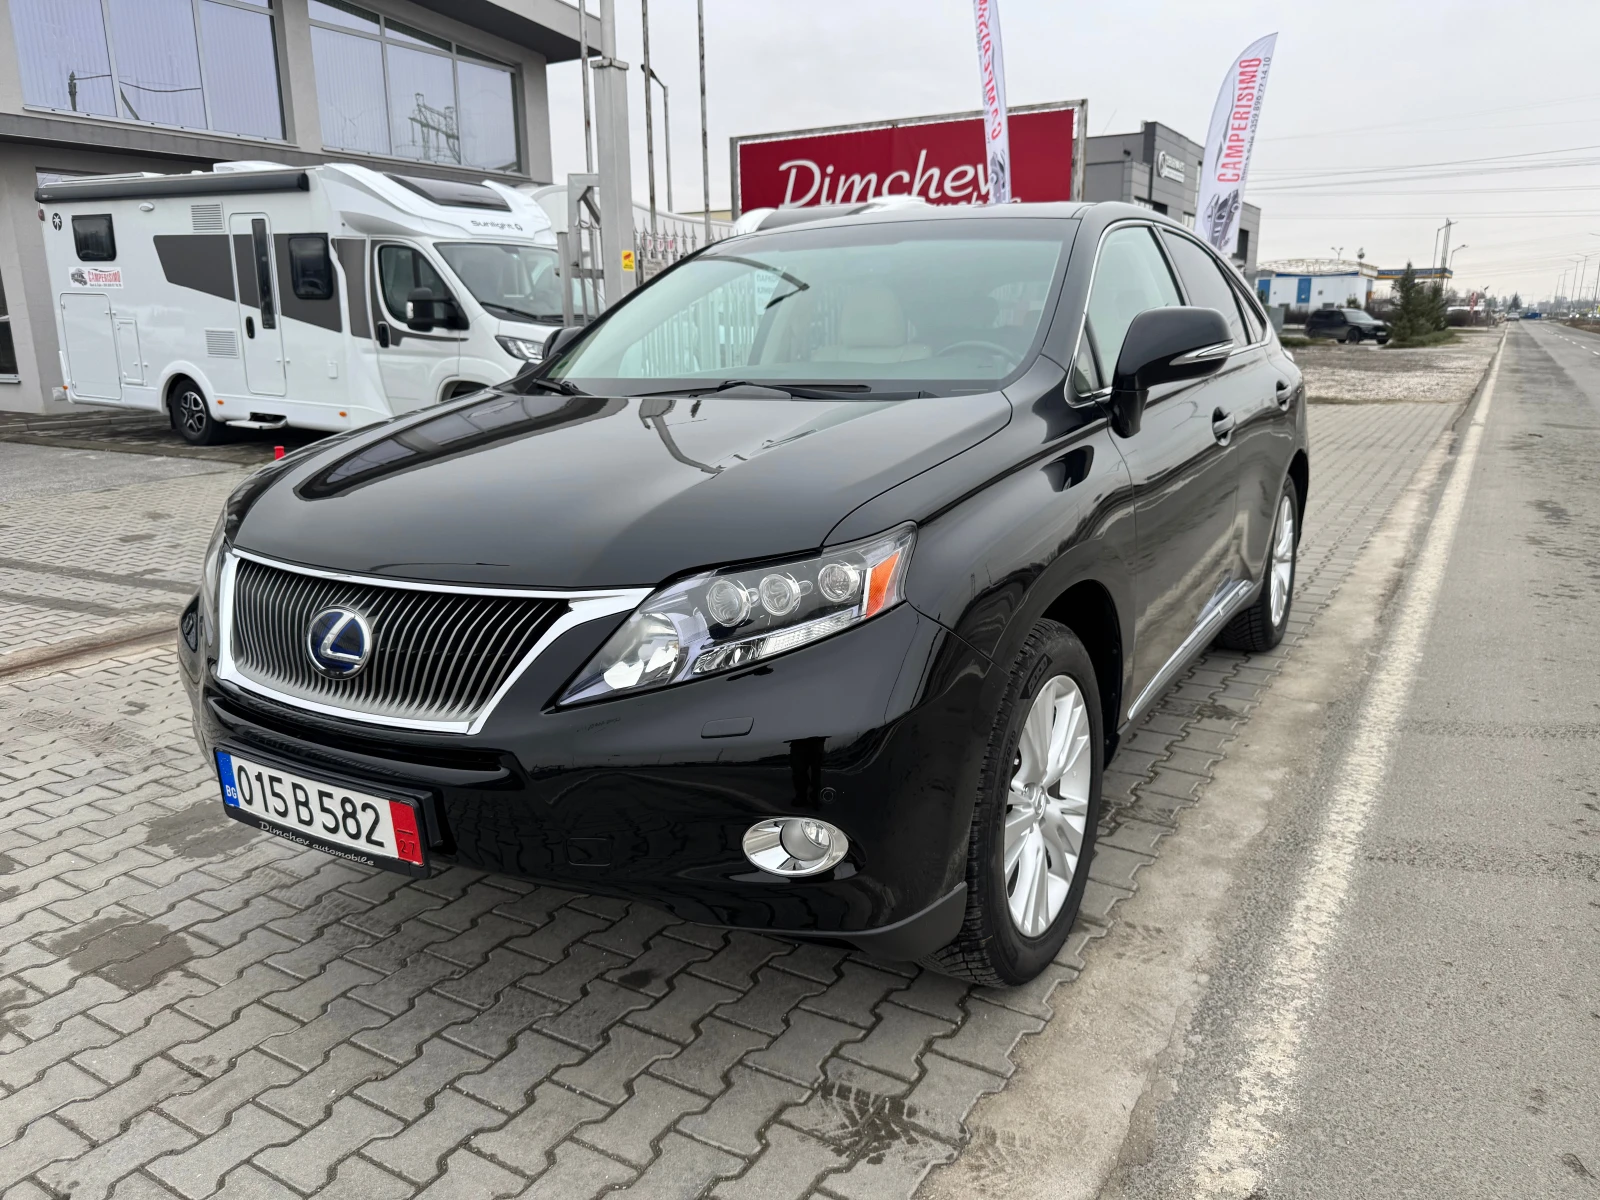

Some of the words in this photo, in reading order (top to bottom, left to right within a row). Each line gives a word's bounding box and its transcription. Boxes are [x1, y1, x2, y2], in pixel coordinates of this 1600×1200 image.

[1263, 56, 1271, 67] 10
[1217, 57, 1262, 183] CAMPERISIMO
[225, 785, 237, 799] BG
[258, 820, 310, 846] Dimchev
[312, 843, 375, 867] automobile
[399, 839, 415, 856] 27
